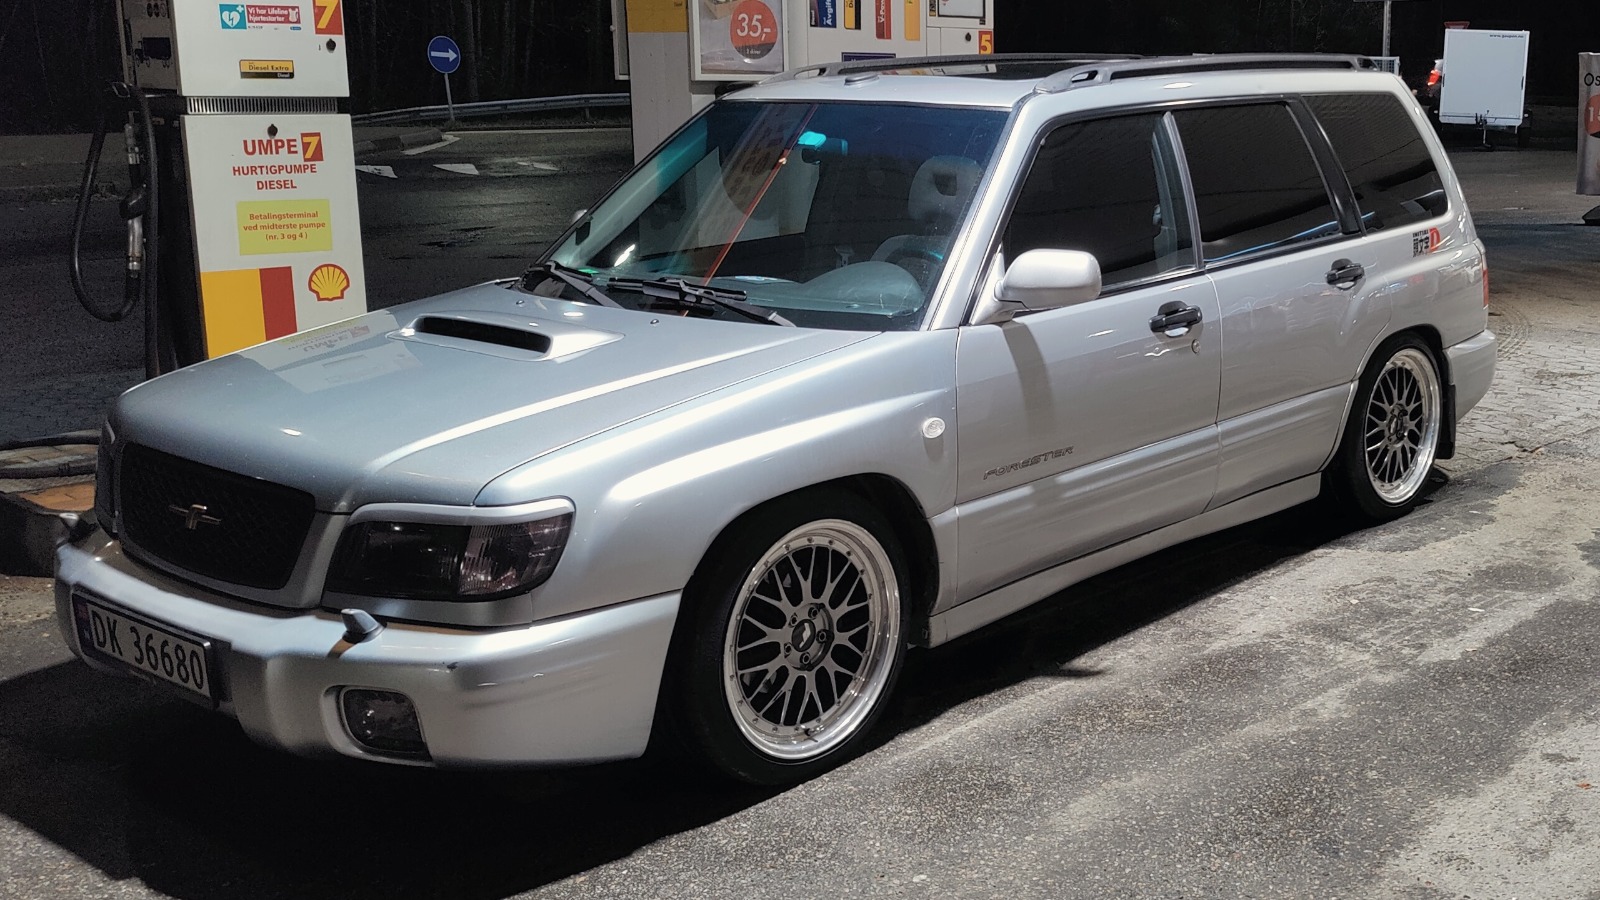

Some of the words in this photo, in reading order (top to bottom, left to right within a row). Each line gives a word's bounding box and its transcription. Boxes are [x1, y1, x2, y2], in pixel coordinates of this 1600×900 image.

[256, 7, 267, 15] har
[315, 0, 339, 29] 7
[248, 15, 285, 23] hjertestarter
[980, 34, 992, 55] 5
[243, 138, 298, 156] UMPE
[302, 136, 320, 159] 7
[232, 163, 317, 176] HURTIGPUMPE
[256, 179, 298, 191] DIESEL
[249, 211, 319, 222] Betalingsterminal
[243, 223, 258, 231] ved
[259, 222, 298, 231] midterste
[298, 221, 326, 231] pumpe
[286, 233, 297, 241] og
[982, 445, 1075, 481] FORESTER
[91, 609, 123, 657] DK
[129, 625, 204, 690] 36680
